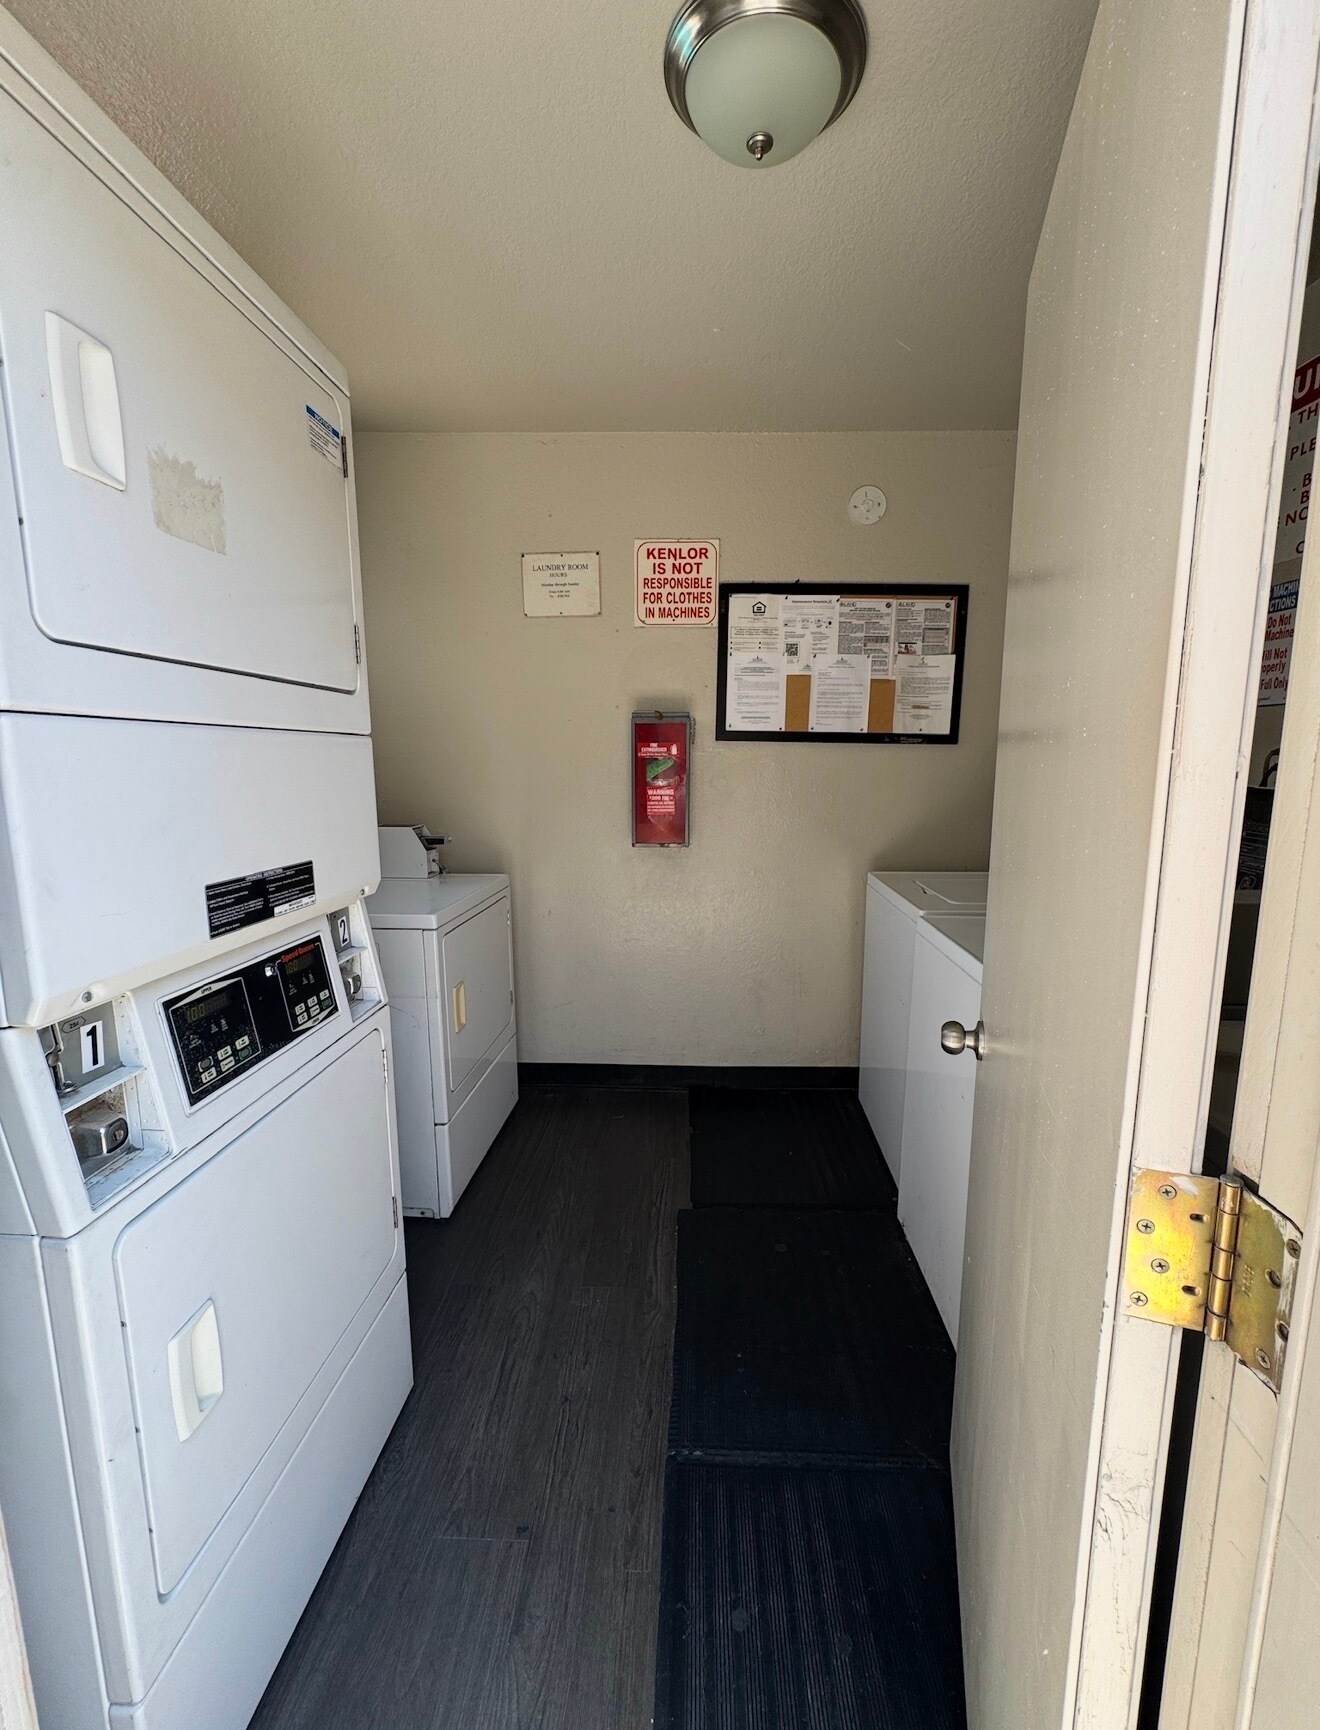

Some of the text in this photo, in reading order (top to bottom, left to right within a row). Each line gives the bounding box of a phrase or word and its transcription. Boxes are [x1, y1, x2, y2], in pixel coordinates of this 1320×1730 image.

[647, 547, 709, 560] KENLOR
[532, 563, 589, 572] LAUNDRY ROOM
[652, 562, 703, 575] IS NOT
[643, 577, 713, 590] RESPONSIBLE
[643, 591, 713, 604] FOR CLOTHES
[645, 606, 710, 618] IN MACHINES
[1278, 614, 1292, 627] Not
[1273, 647, 1288, 660] Not
[1273, 676, 1289, 691] Only
[339, 919, 348, 944] 2
[281, 943, 315, 963] Speed Queen
[86, 1025, 99, 1067] 1
